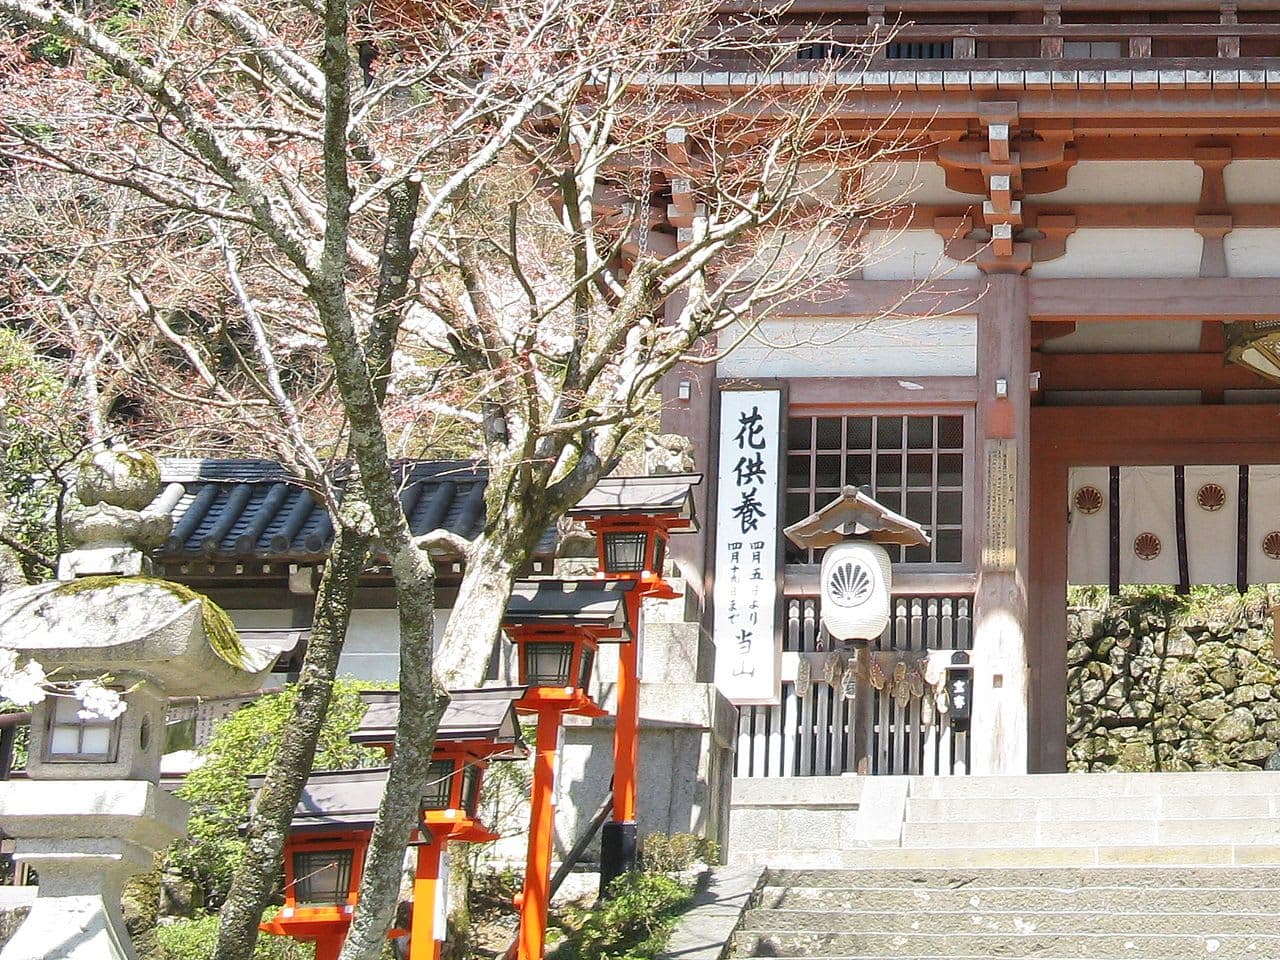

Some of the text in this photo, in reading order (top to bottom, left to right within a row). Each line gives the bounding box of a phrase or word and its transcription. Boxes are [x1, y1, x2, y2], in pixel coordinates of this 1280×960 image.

[732, 406, 767, 534] 花供養
[732, 629, 755, 678] 当山
